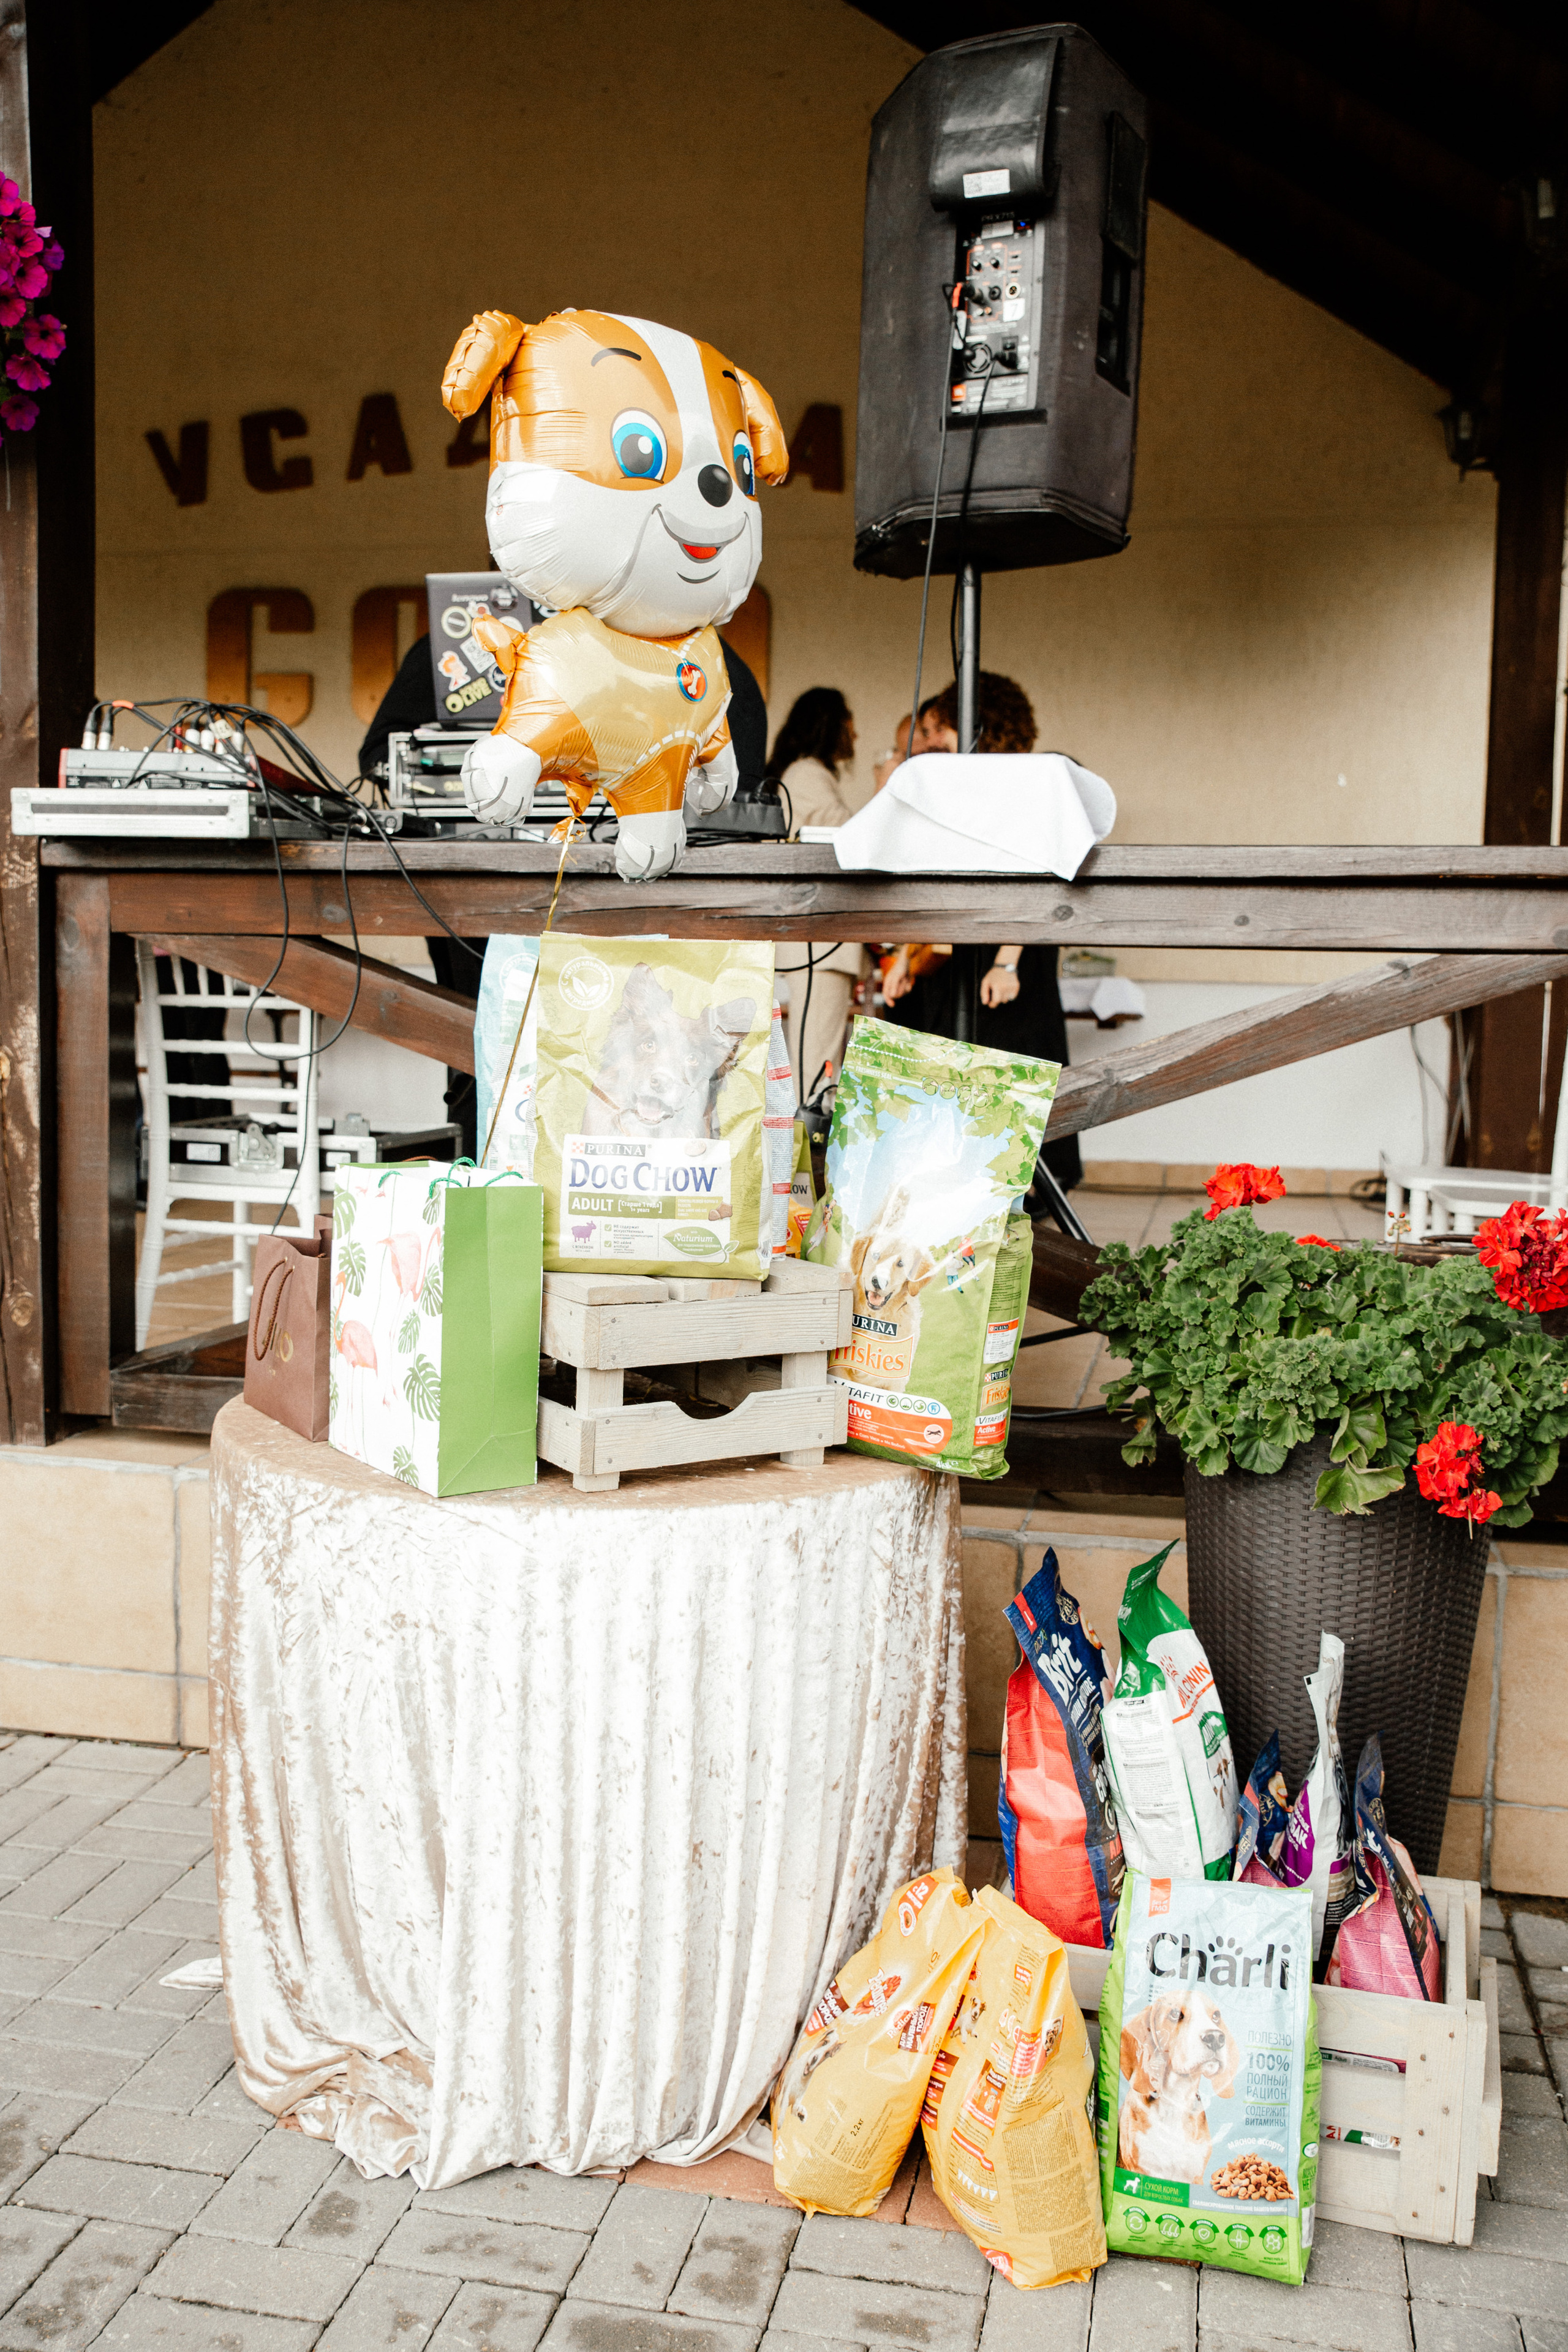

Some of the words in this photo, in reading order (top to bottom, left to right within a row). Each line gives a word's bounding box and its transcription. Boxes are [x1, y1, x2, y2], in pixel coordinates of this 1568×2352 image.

[856, 1066, 880, 1077] FRESHNESS
[586, 1144, 644, 1156] PURINA
[790, 1185, 808, 1195] OW
[571, 1197, 614, 1212] ADULT
[673, 1232, 714, 1242] Naturium
[852, 1315, 896, 1335] URINA
[848, 1403, 872, 1419] tive
[977, 1425, 996, 1434] Active
[1037, 1632, 1082, 1707] Brit
[1146, 1932, 1291, 1990] Charli
[917, 2005, 929, 2037] ПОРОД
[1248, 2030, 1292, 2046] ПОЛЕЗНО
[1247, 2052, 1289, 2072] 100%
[1247, 2072, 1288, 2087] ПОЛНЫЙ
[1246, 2086, 1287, 2101] РАЦИОН
[1246, 2105, 1286, 2118] СОДЕРЖИТ
[1245, 2117, 1286, 2128] ВИТАМИНЫ
[1257, 2138, 1285, 2154] ассорти
[1145, 2182, 1162, 2192] СУХОЙ
[1163, 2186, 1179, 2195] КОРМ
